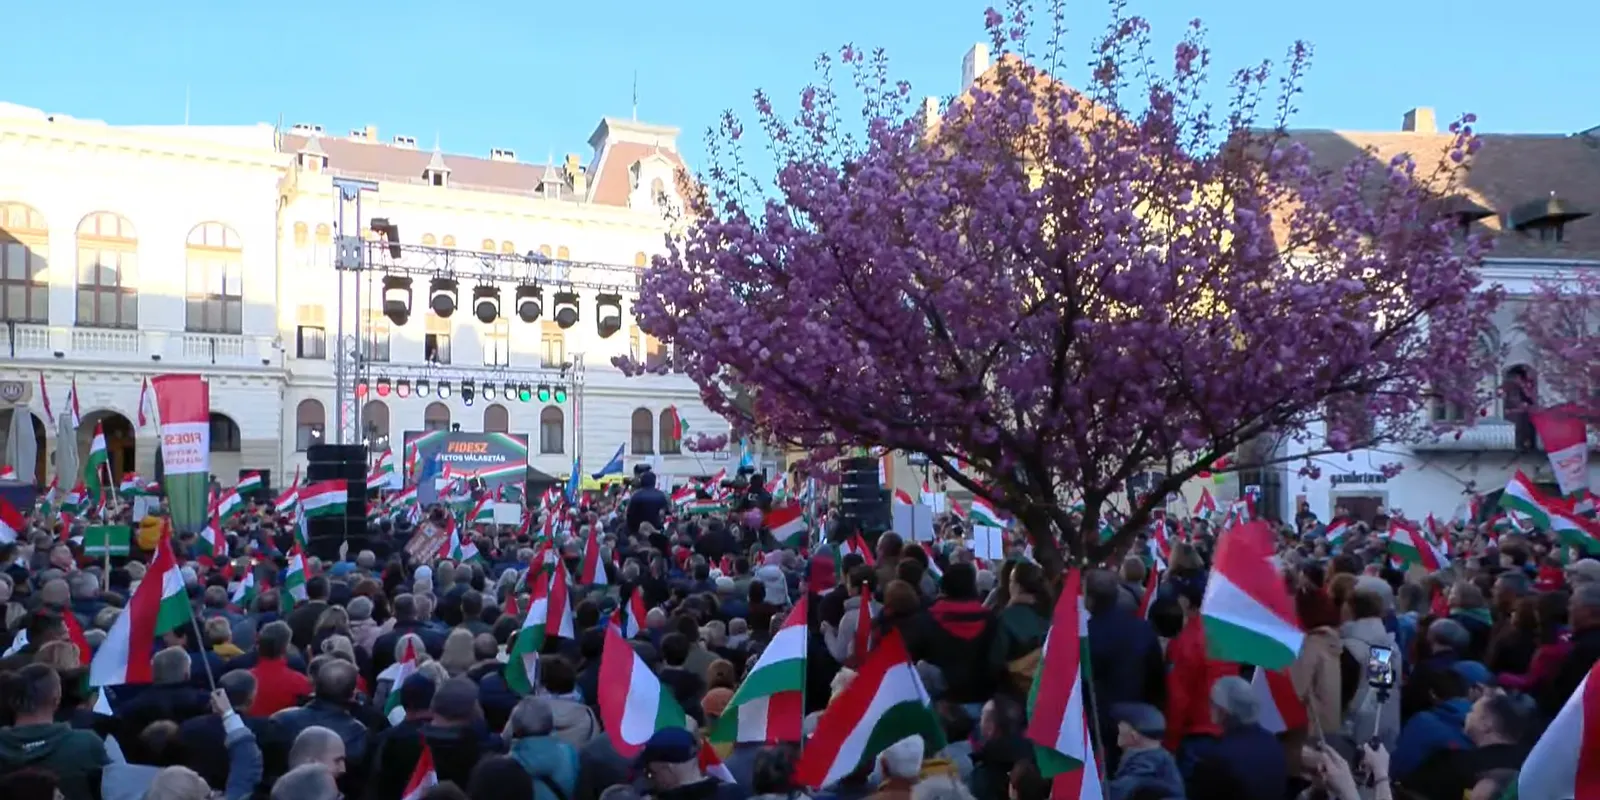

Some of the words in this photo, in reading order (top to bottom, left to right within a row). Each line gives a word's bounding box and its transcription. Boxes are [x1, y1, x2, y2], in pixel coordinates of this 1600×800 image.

[447, 441, 489, 453] FIDESZ
[438, 453, 463, 462] IZTOS
[464, 452, 506, 462] VÁLASZTÁS
